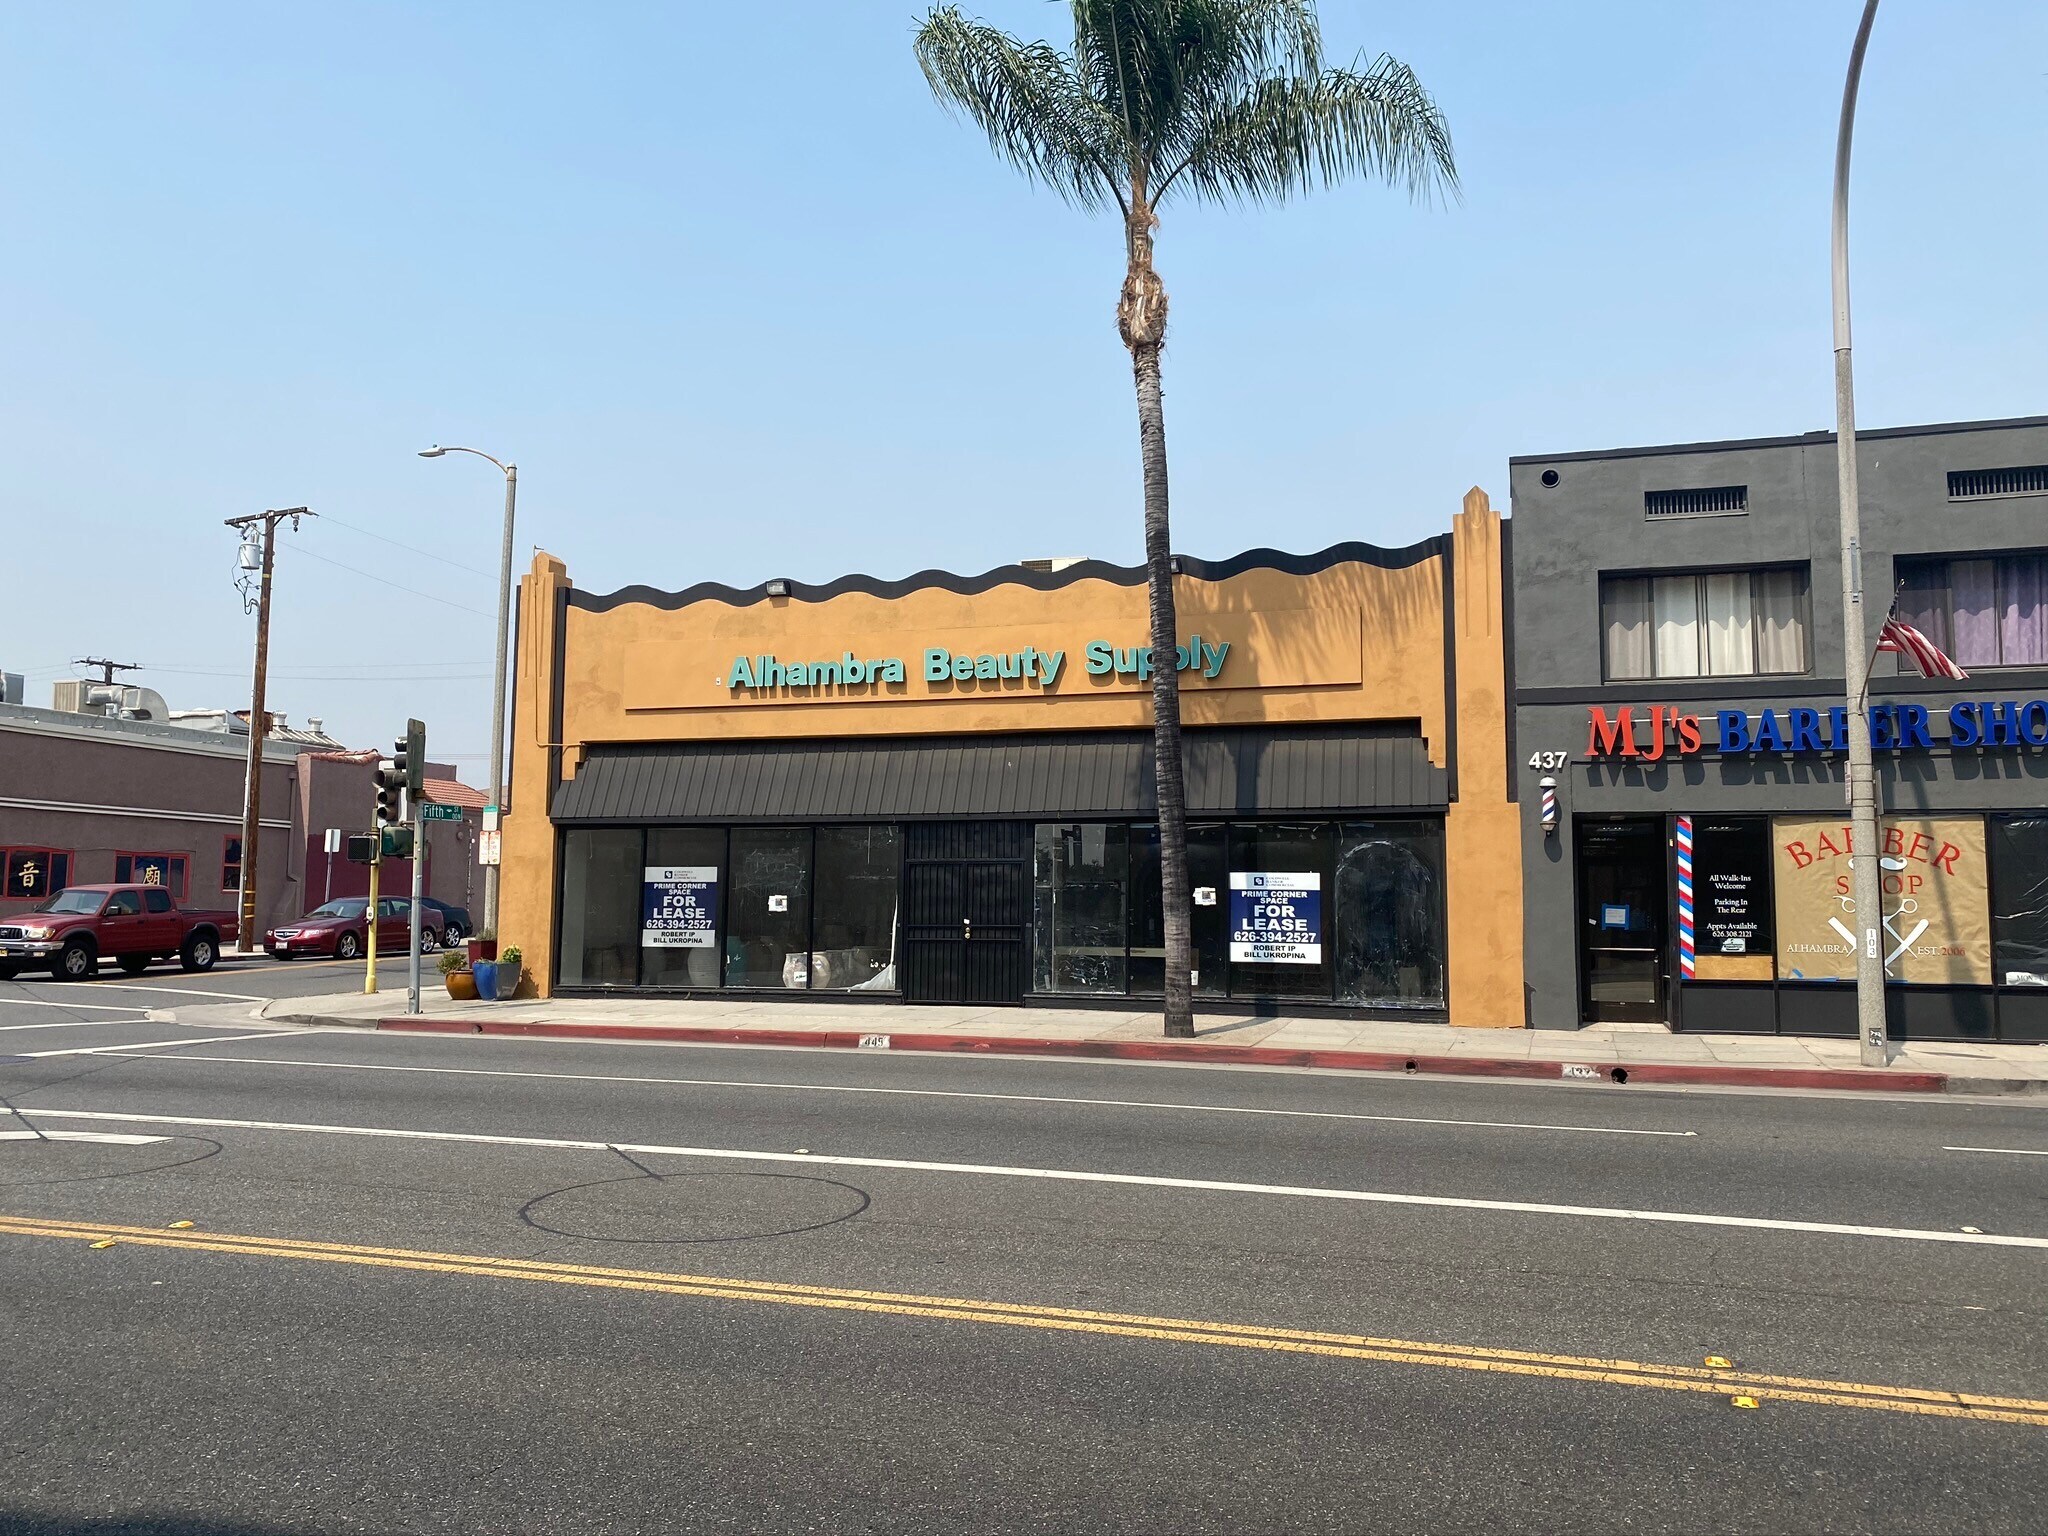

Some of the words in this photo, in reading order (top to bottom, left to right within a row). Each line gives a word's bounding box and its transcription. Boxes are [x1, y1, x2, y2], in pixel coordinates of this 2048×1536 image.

[726, 651, 904, 688] Alhambra
[924, 647, 1065, 685] Beauty
[1584, 705, 1702, 761] MJ's
[1528, 751, 1567, 769] 437
[424, 805, 444, 818] Fifth
[19, 861, 39, 888] 音
[142, 865, 161, 886] 廟
[1836, 875, 1923, 895] SOP
[663, 896, 696, 907] FOR
[653, 908, 706, 918] LEASE
[1254, 905, 1295, 917] FOR
[646, 920, 712, 928] 626-394-2527
[1242, 918, 1307, 931] LEASE
[1234, 931, 1316, 942] 626-394-2527
[1786, 944, 1849, 954] ALHAMBRA
[1917, 946, 1941, 956] EST.
[1942, 948, 1966, 956] 2006
